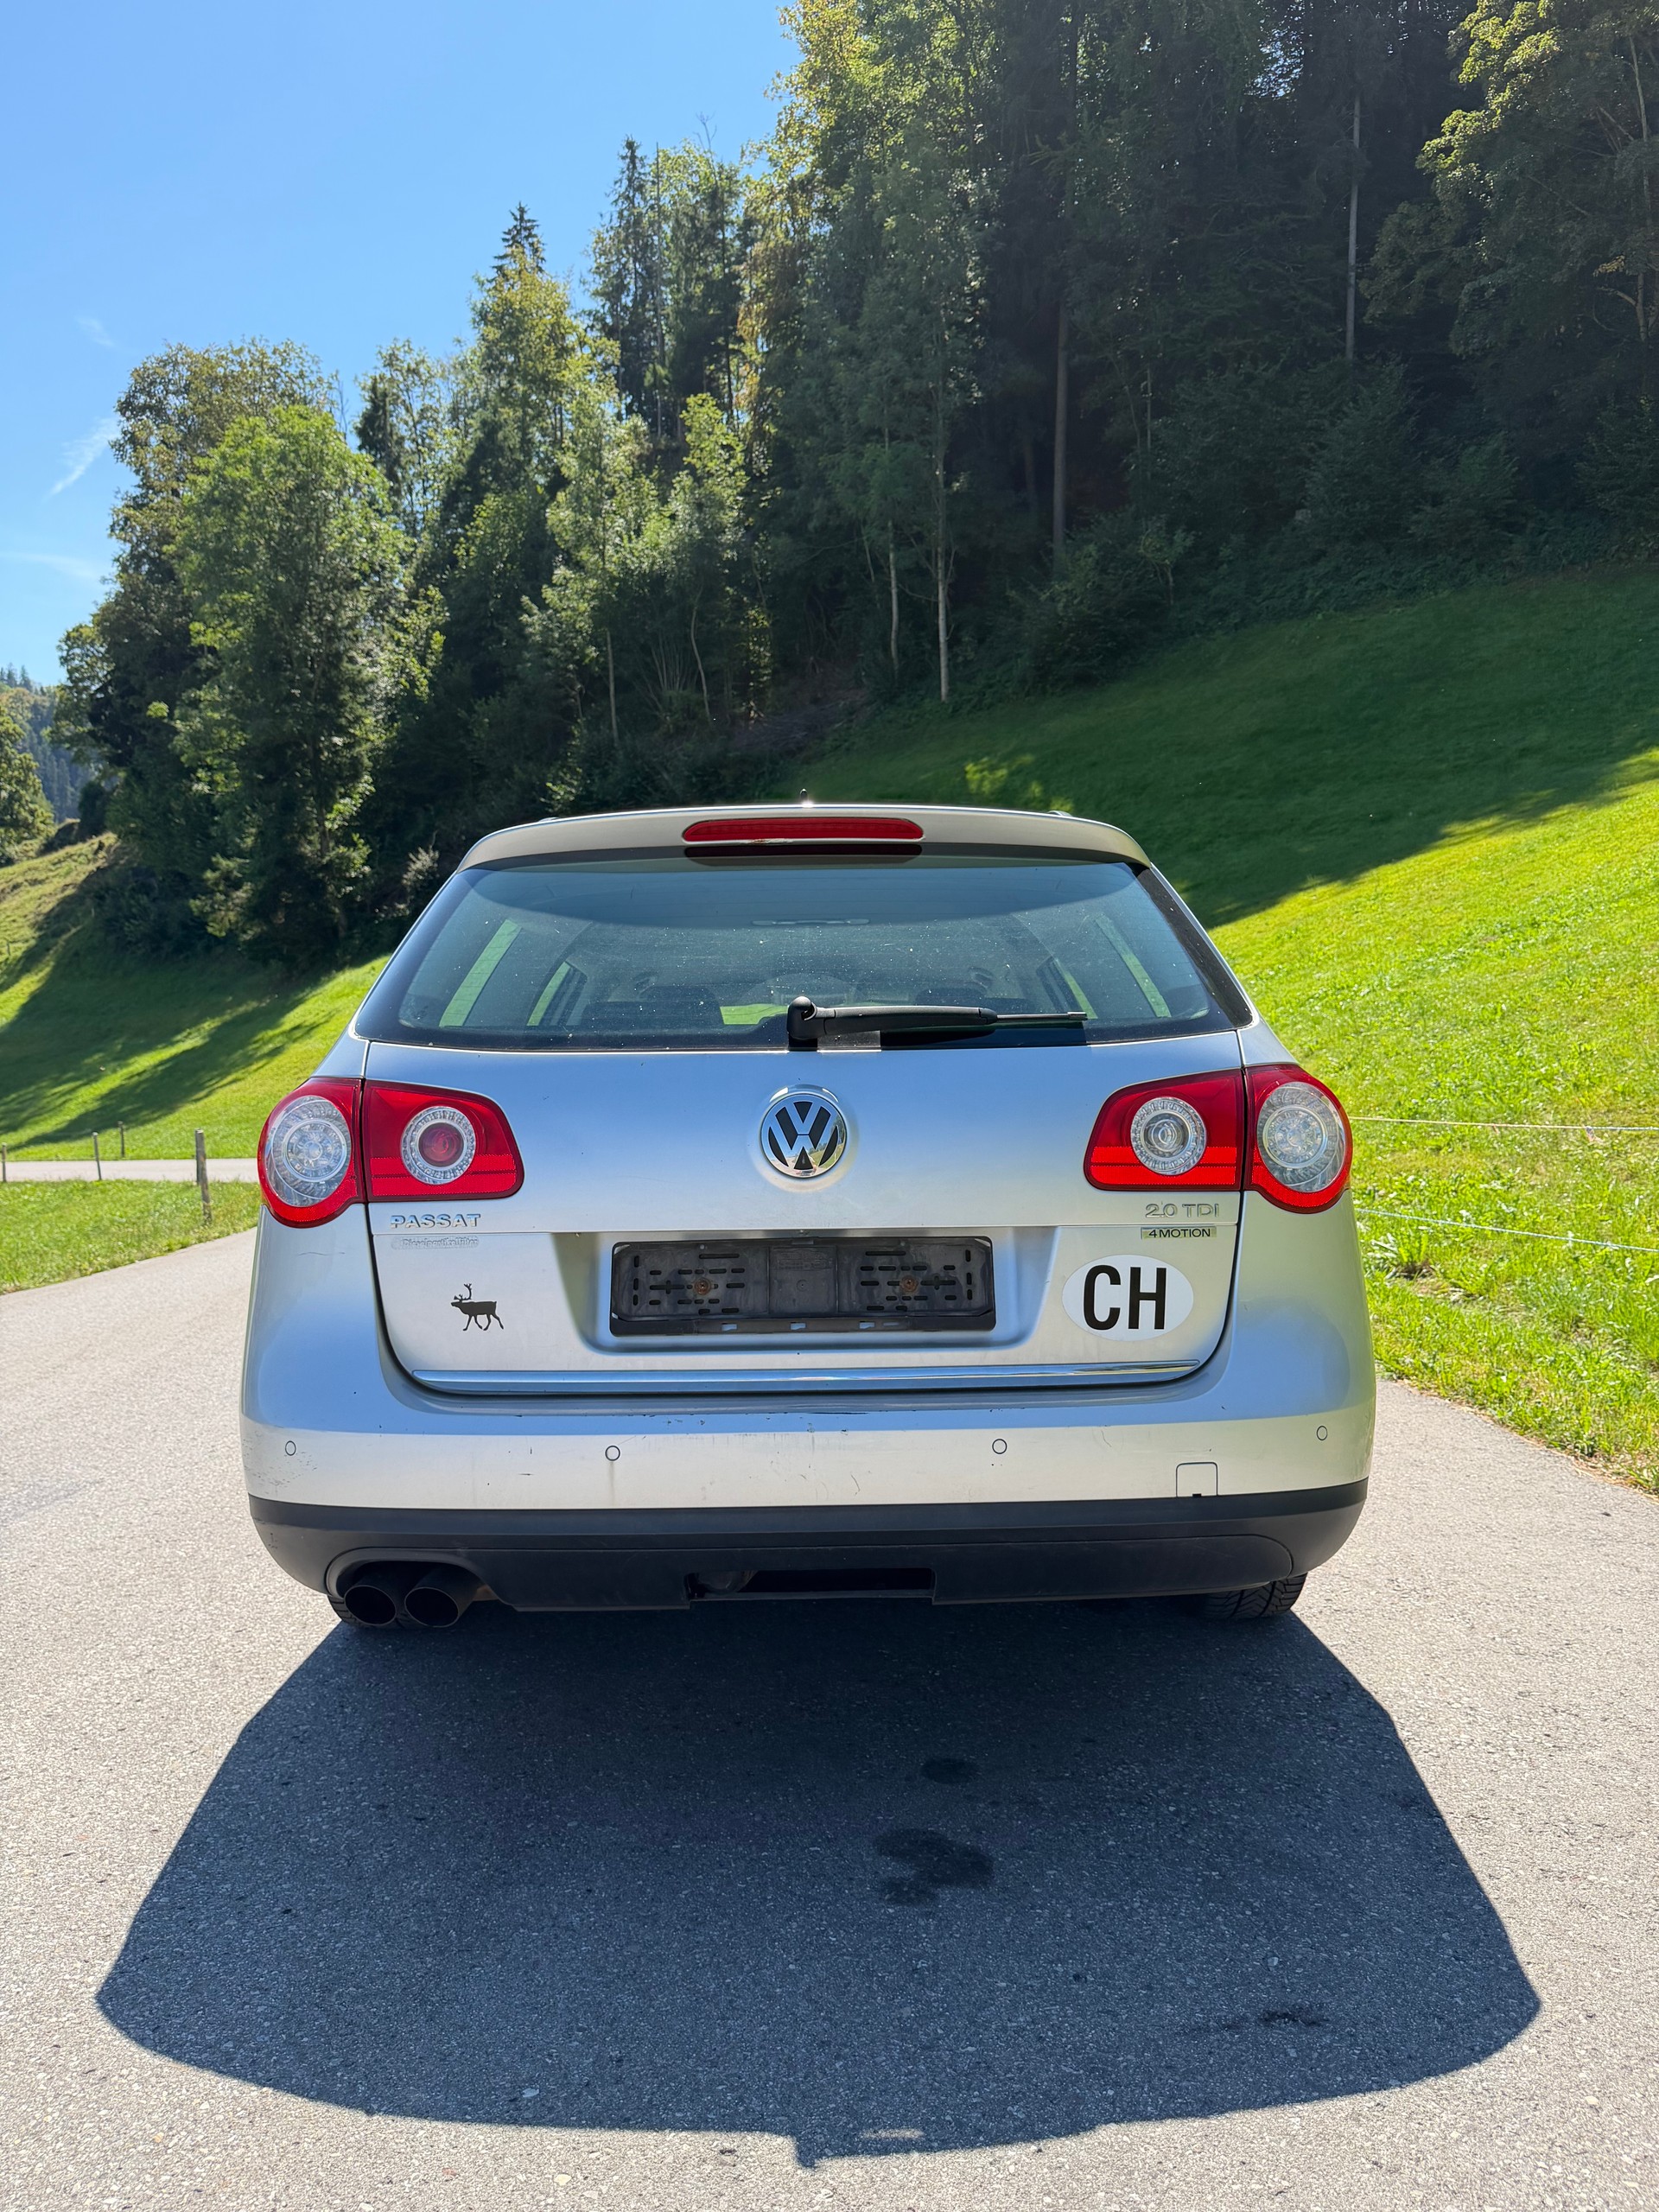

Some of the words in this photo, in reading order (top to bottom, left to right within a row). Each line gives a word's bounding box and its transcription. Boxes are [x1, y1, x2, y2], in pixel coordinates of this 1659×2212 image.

[765, 1096, 842, 1173] VW
[1145, 1203, 1178, 1218] 2.0
[1182, 1203, 1219, 1217] TDI
[391, 1213, 480, 1228] PASSAT
[1148, 1228, 1211, 1238] 4MOTION
[1083, 1264, 1167, 1331] CH
